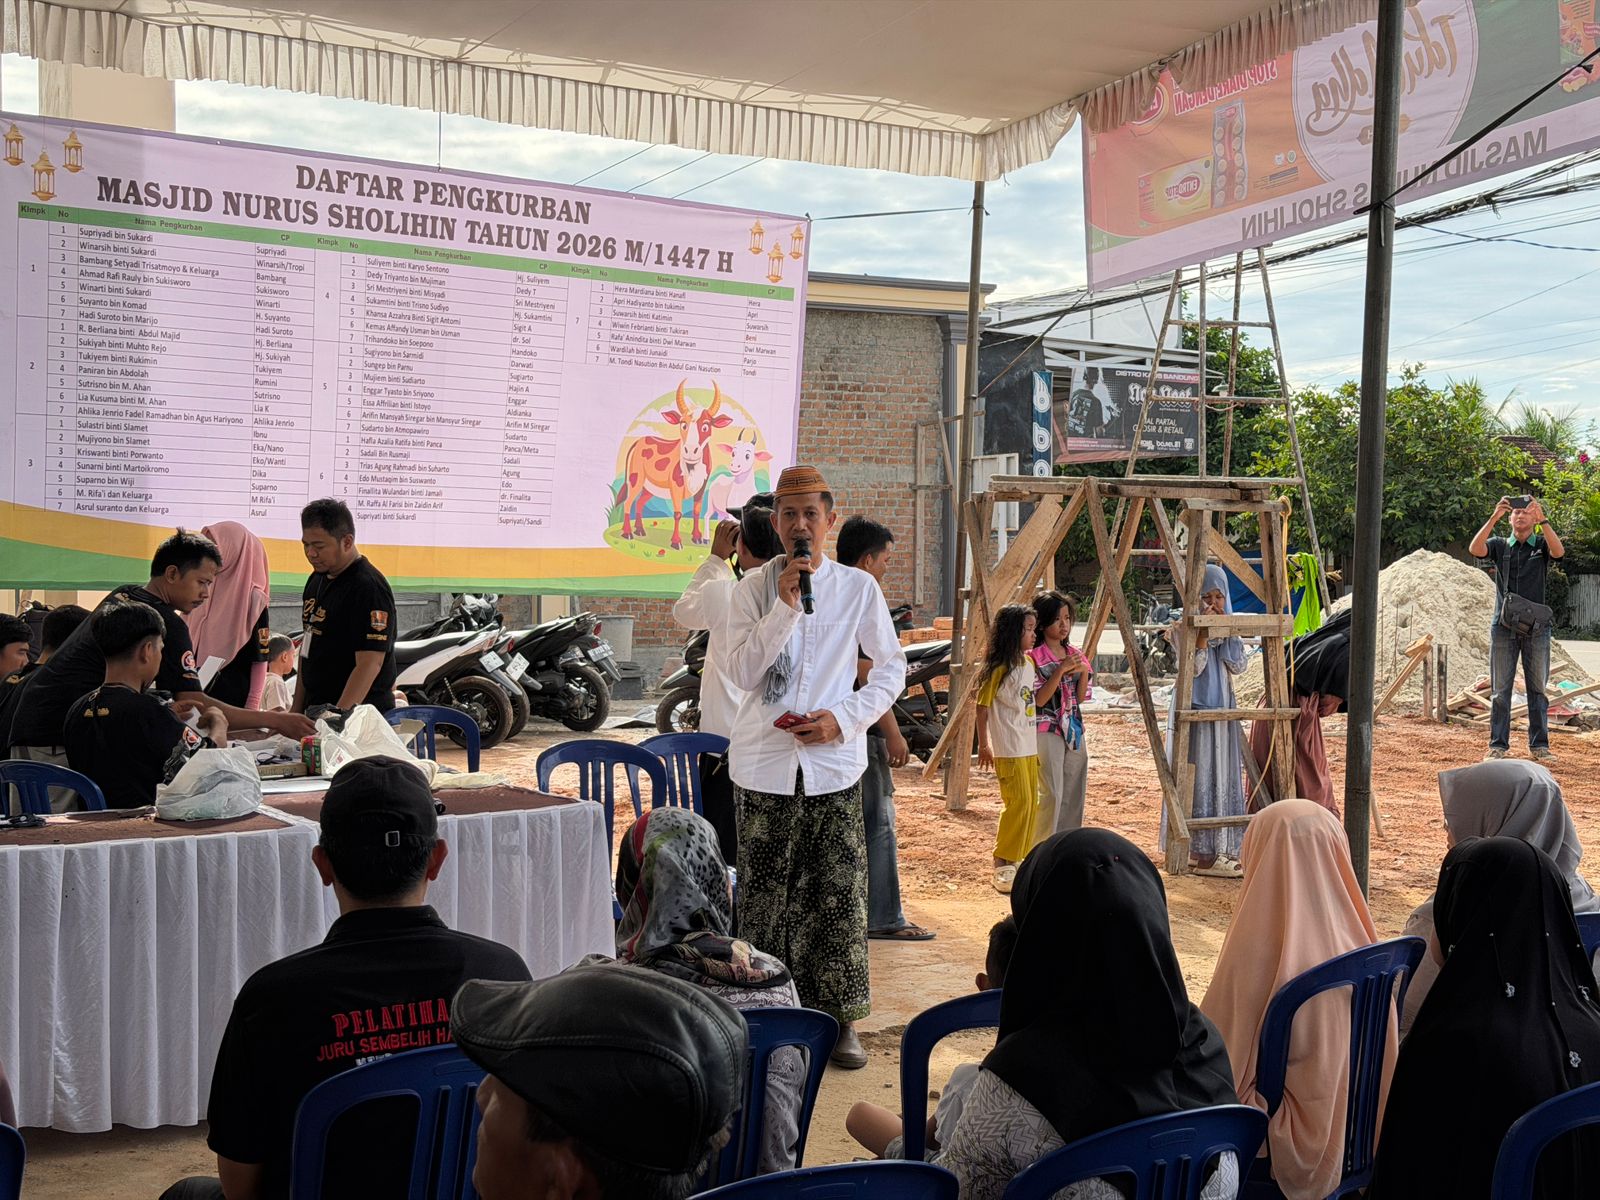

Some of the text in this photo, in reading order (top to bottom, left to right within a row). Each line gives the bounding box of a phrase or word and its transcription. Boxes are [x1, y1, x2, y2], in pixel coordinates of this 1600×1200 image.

[296, 164, 591, 224] DAFTAR PENGKURBAN
[58, 210, 69, 218] No
[135, 218, 156, 227] Nama
[160, 220, 203, 232] Pengkurban
[97, 176, 734, 273] MASJID NURUS SHOLIHIN TAHUN 2026 M/1447 H
[79, 227, 112, 238] Supriyadi
[114, 230, 126, 240] bin
[126, 232, 153, 242] Sukardi
[79, 240, 112, 252] Winarsih
[112, 243, 129, 254] binti
[130, 246, 156, 256] Sukardi
[414, 248, 432, 257] Nama
[434, 250, 471, 261] Pengkurban
[79, 254, 113, 267] Bambang
[113, 257, 140, 269] Setyadi
[140, 260, 180, 273] Trisatmoyo
[188, 264, 219, 277] Keluarga
[657, 275, 673, 284] Nama
[78, 294, 108, 306] Suyanto
[109, 298, 121, 308] bin
[122, 299, 147, 310] Komad
[87, 324, 117, 335] Berliana
[118, 326, 135, 336] binti
[138, 328, 158, 338] Abdul
[160, 330, 180, 341] Majid
[78, 337, 107, 348] Sukiyah
[106, 339, 124, 349] binti
[125, 341, 149, 352] Muhto
[150, 343, 166, 353] Rejo
[78, 364, 106, 375] Paniran
[106, 366, 119, 375] bin
[119, 368, 149, 378] Abdolah
[77, 406, 101, 416] Ahlika
[100, 408, 124, 417] Jenrio
[123, 408, 144, 418] Fadel
[144, 409, 182, 420] Ramadhan
[183, 412, 194, 421] bin
[195, 413, 212, 423] Agus
[213, 415, 243, 424] Hariyono
[1164, 426, 1184, 435] RETAIL
[76, 434, 112, 444] Mujiyono
[112, 435, 124, 444] bin
[125, 436, 150, 445] Slamet
[76, 447, 111, 457] Kriswanti
[111, 448, 128, 459] binti
[129, 449, 163, 460] Porwanto
[76, 461, 103, 470] Sunarni
[105, 462, 122, 471] binti
[123, 463, 169, 473] Martoikromo
[76, 502, 94, 511] Asrul
[95, 503, 123, 512] suranto
[123, 503, 138, 512] dan
[138, 504, 169, 515] Keluarga
[316, 1040, 355, 1062] JURU
[360, 1030, 431, 1053] SEMBELIH
